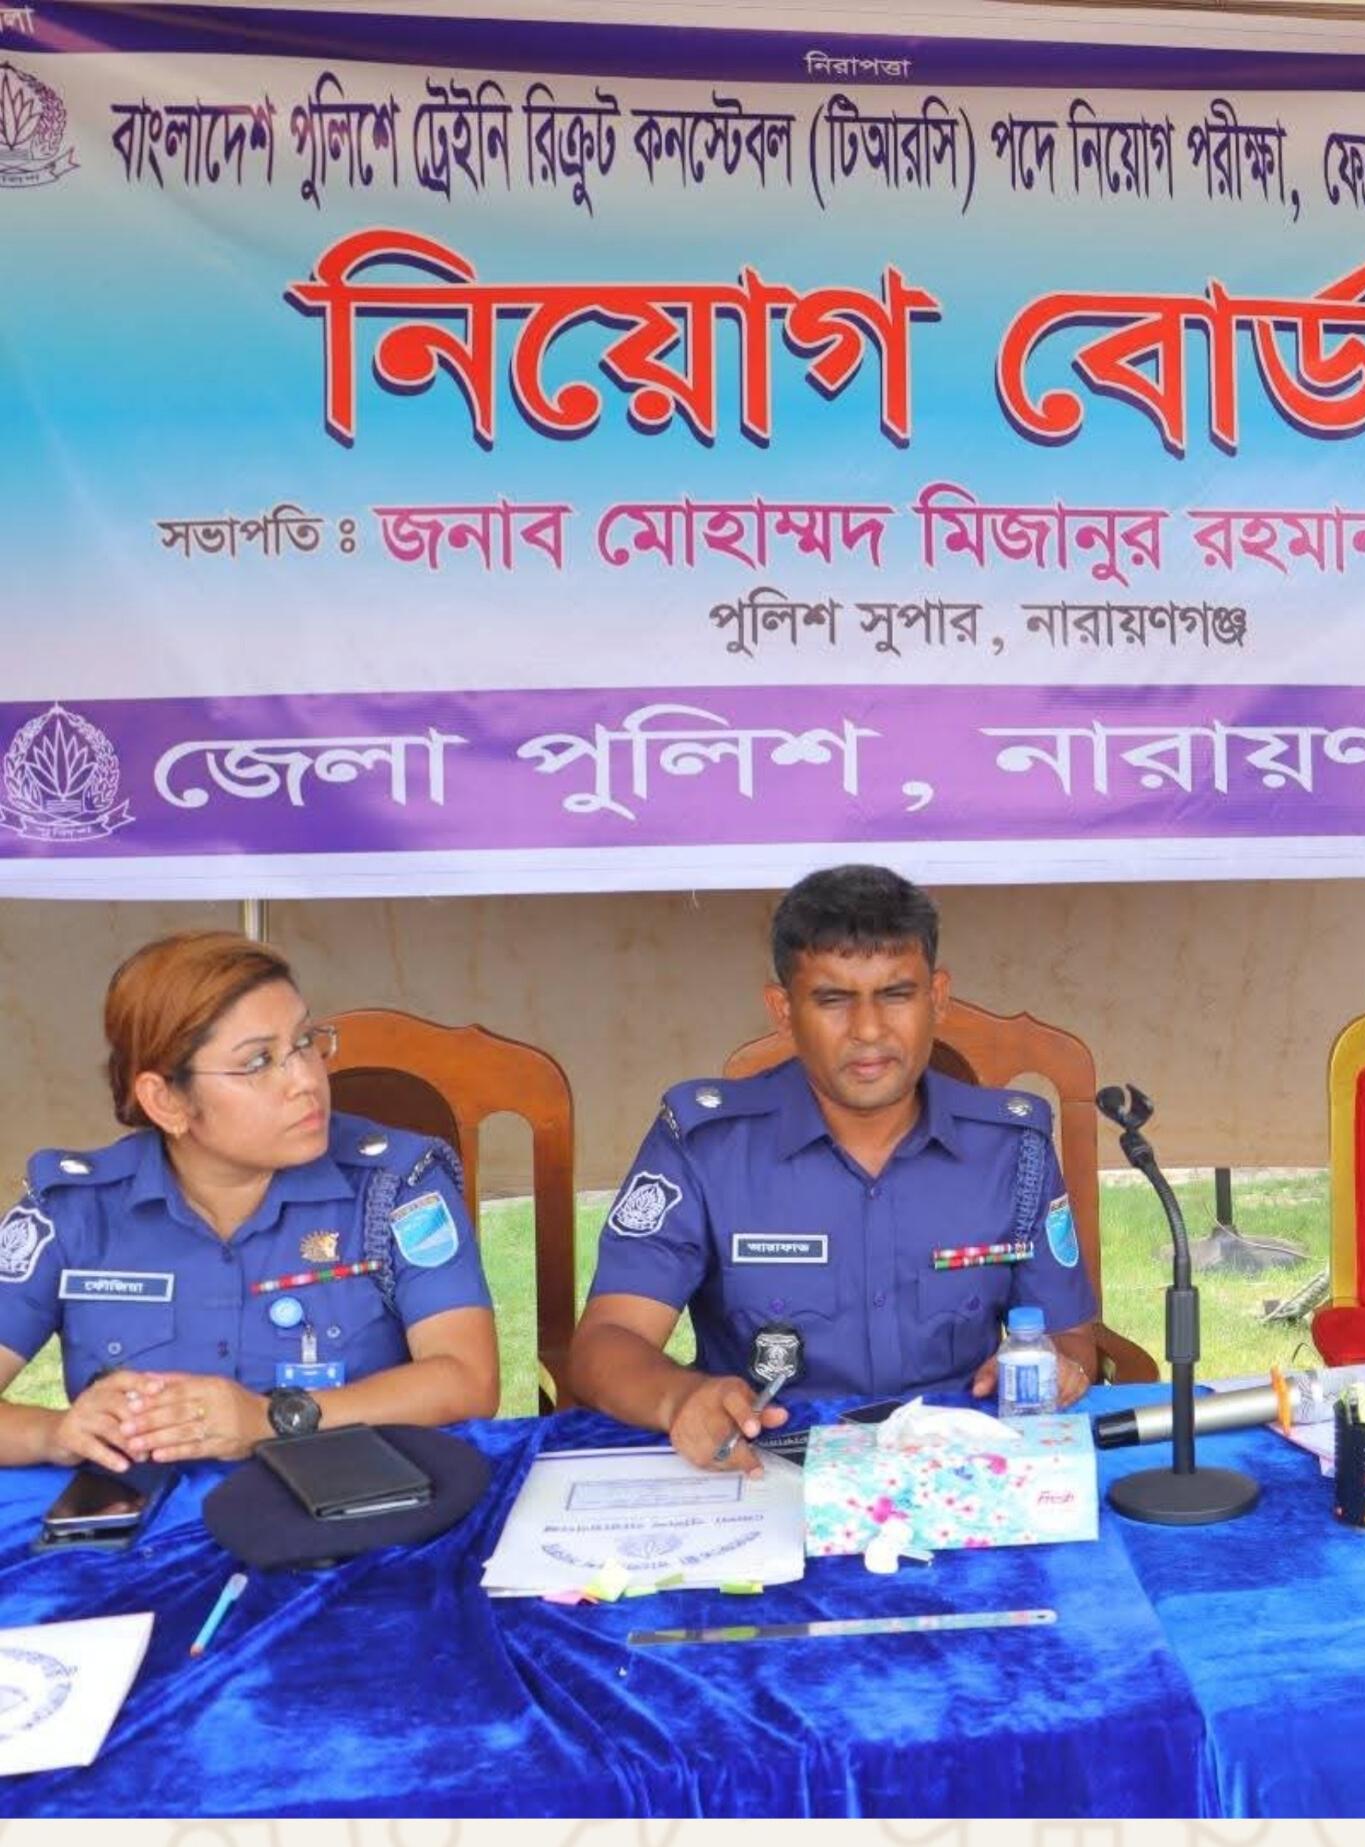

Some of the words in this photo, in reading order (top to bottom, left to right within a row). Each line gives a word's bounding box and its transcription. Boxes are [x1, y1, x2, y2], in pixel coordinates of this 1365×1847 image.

[805, 49, 912, 78] নিরাপত্তা
[111, 97, 274, 190] বাংলাদেশ
[292, 71, 400, 210] পুলিশে
[413, 77, 510, 203] ট্রেইনি
[522, 82, 620, 217] রিক্রুট
[631, 84, 796, 190] কনস্টেবল
[809, 93, 977, 214] (টিআরসি)
[991, 114, 1060, 199] পদে
[1068, 98, 1175, 200] নিয়োগ
[1187, 97, 1300, 224] পরীক্ষা,
[283, 228, 941, 451] নিয়োগ
[156, 504, 324, 558] সভাপতি
[372, 494, 577, 571] জনাব
[596, 494, 895, 571] মোহাম্মদ
[914, 482, 1170, 589] মিজানুর
[709, 586, 841, 658] পুলিশ
[1021, 599, 1248, 650] নারায়ণগঞ্জ
[153, 726, 470, 808] জেলা
